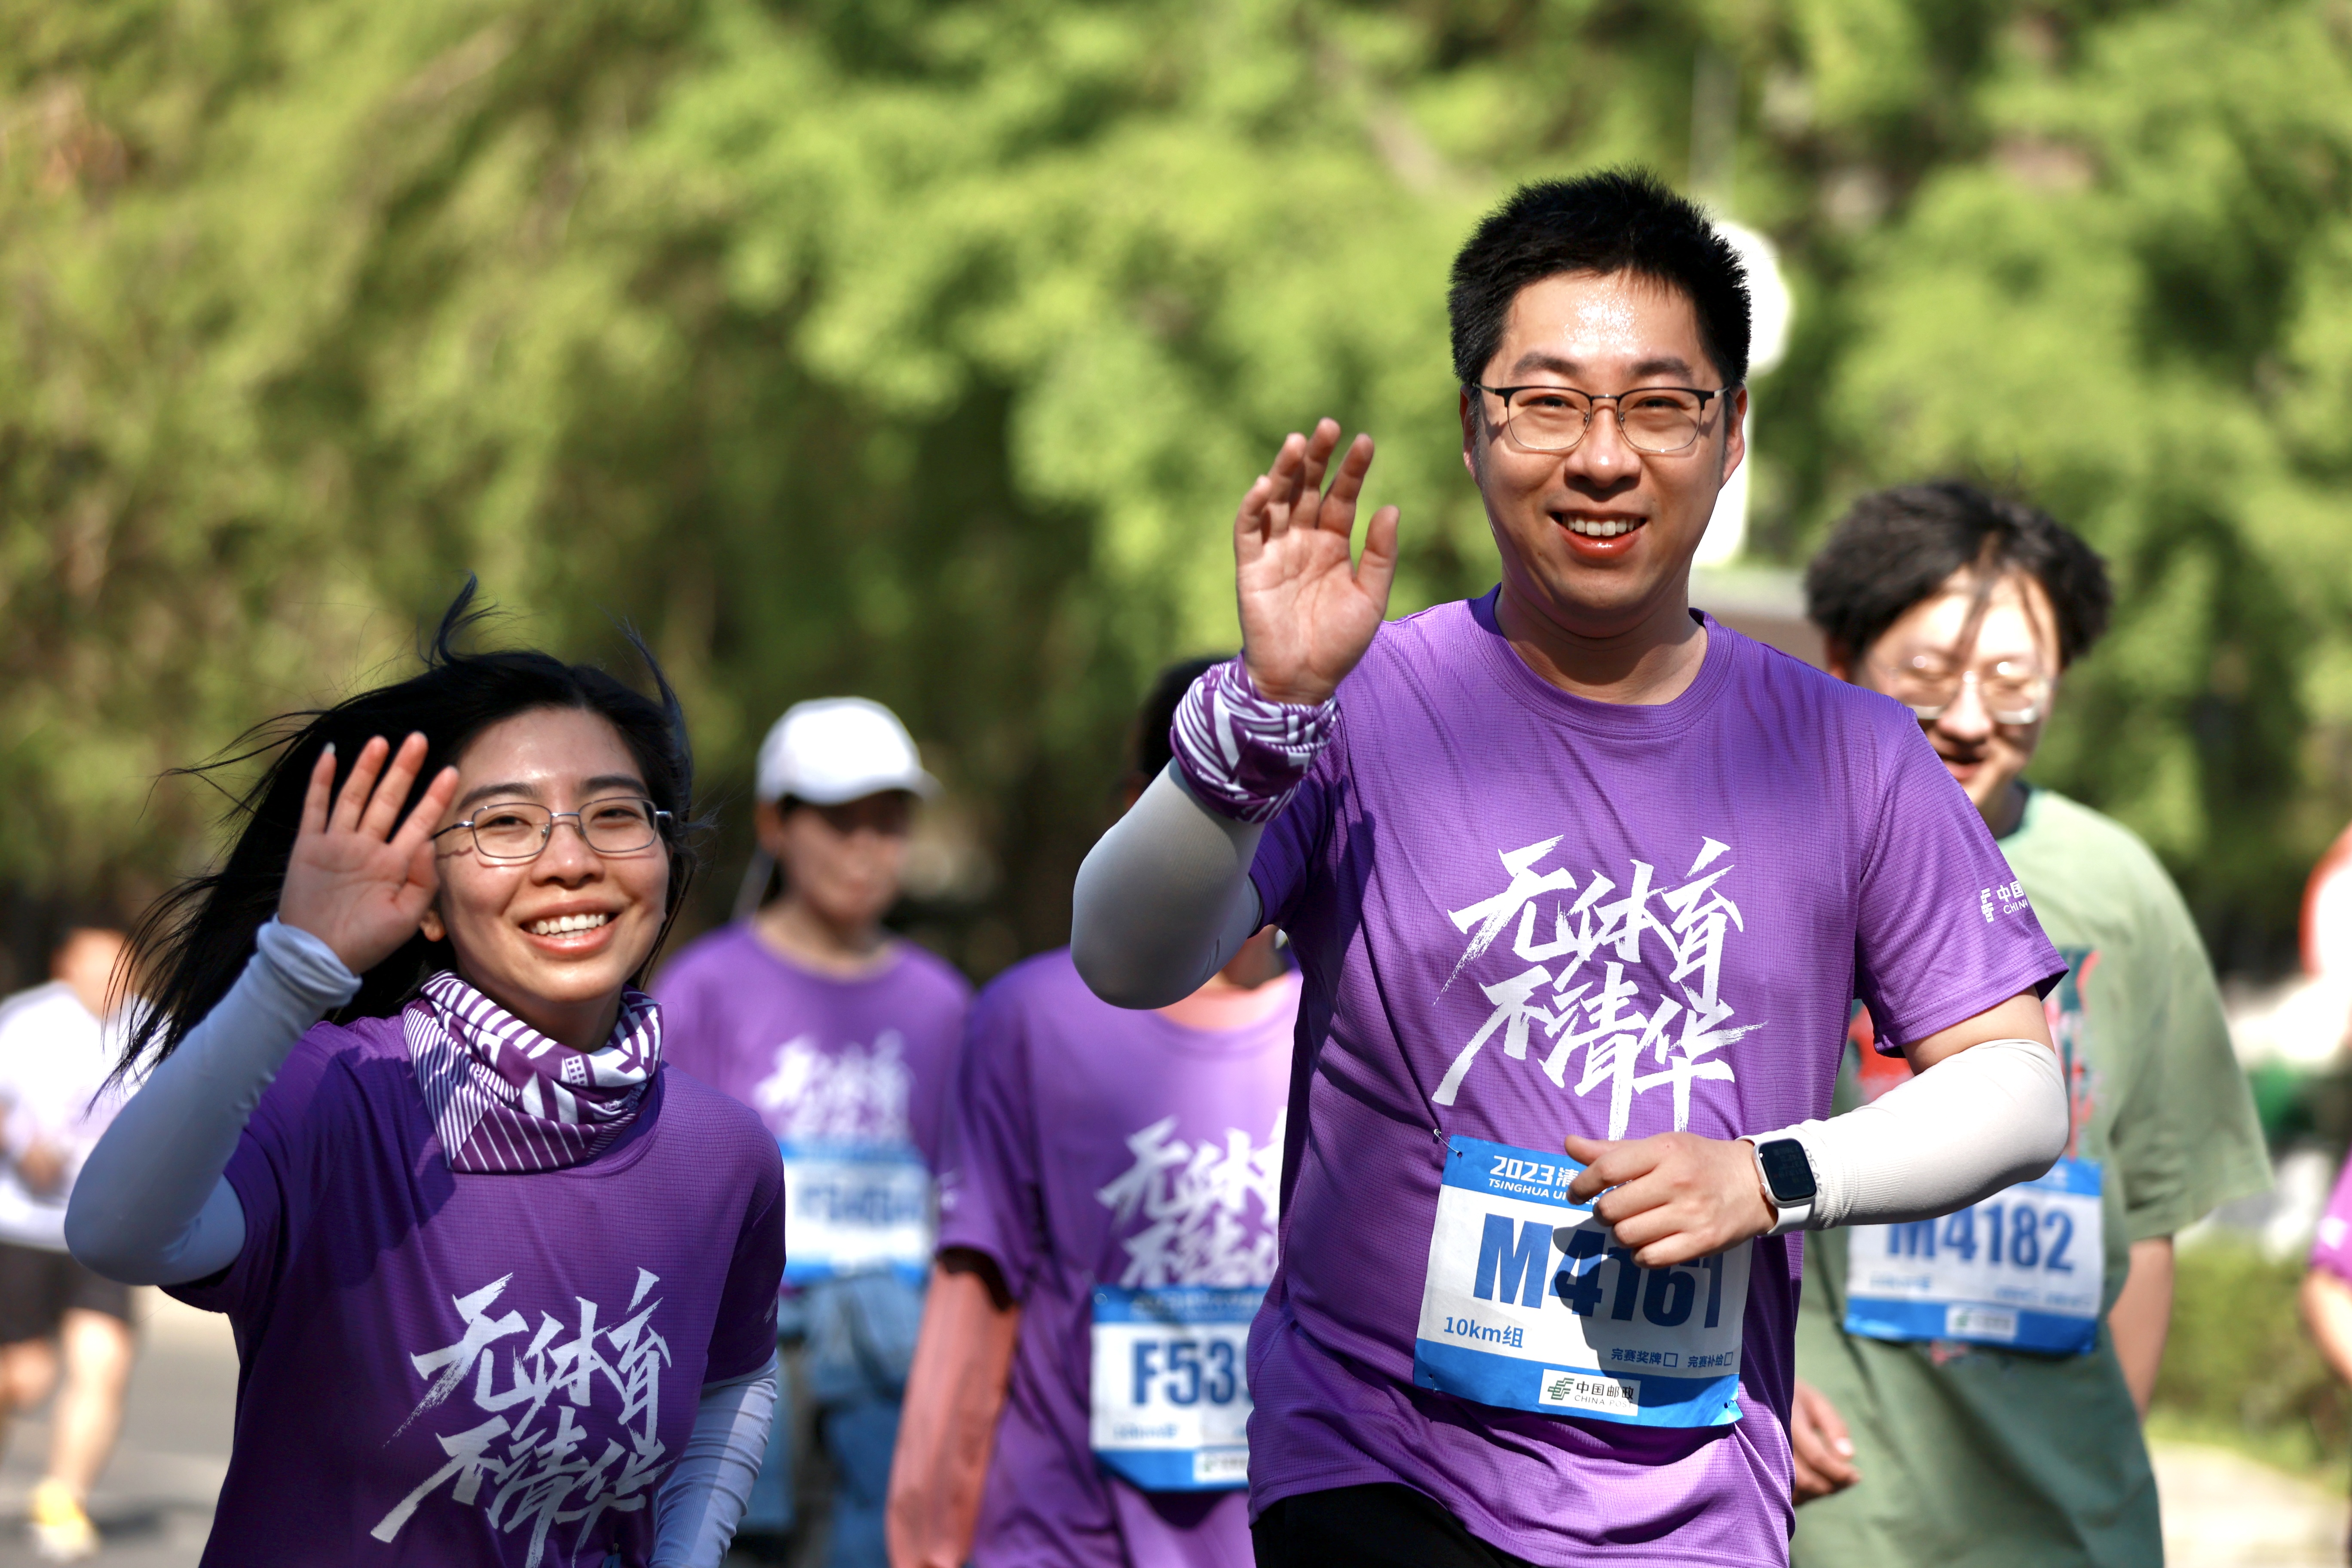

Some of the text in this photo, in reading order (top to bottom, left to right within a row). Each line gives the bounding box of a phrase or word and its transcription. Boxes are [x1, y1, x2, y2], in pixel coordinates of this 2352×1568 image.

[1997, 880, 2024, 902] 中国
[1433, 834, 1744, 1015] 无体育
[1432, 961, 1768, 1141] 不清华
[1489, 1178, 1549, 1197] TSINGHUA
[1886, 1203, 2074, 1274] M4182
[1473, 1213, 1723, 1328] M4161
[1444, 1317, 1523, 1348] 10km组
[1611, 1348, 1662, 1365] 完赛奖牌
[383, 1267, 671, 1455] 无体育
[1132, 1340, 1253, 1407] F53
[1687, 1354, 1723, 1368] 完赛补给
[1574, 1395, 1633, 1408] CHINA POST
[1576, 1381, 1634, 1400] 中国邮政
[371, 1406, 676, 1568] 不清华
